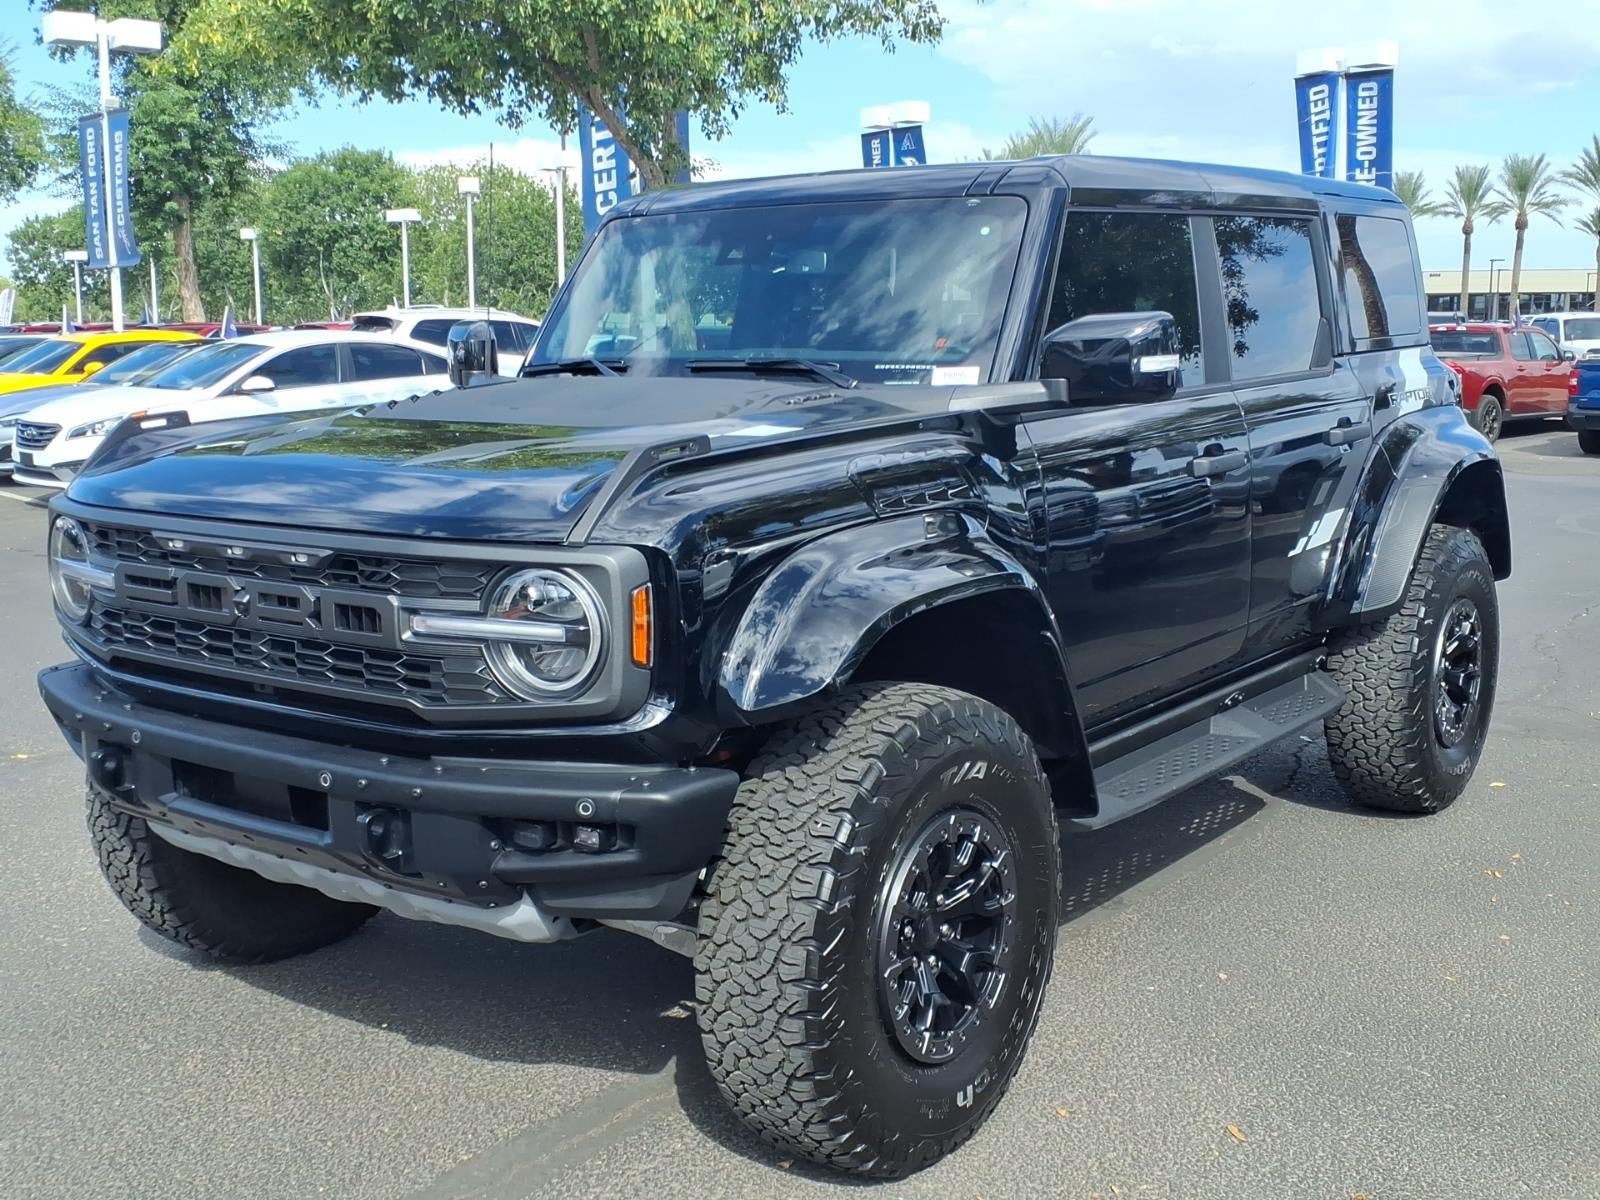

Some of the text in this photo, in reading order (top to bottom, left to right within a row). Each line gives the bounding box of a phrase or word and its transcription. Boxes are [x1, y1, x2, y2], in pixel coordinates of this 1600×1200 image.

[86, 127, 104, 260] SAN TAN FORD
[114, 130, 125, 226] CUSTOMS
[591, 113, 618, 216] CERT
[113, 562, 401, 649] FORD
